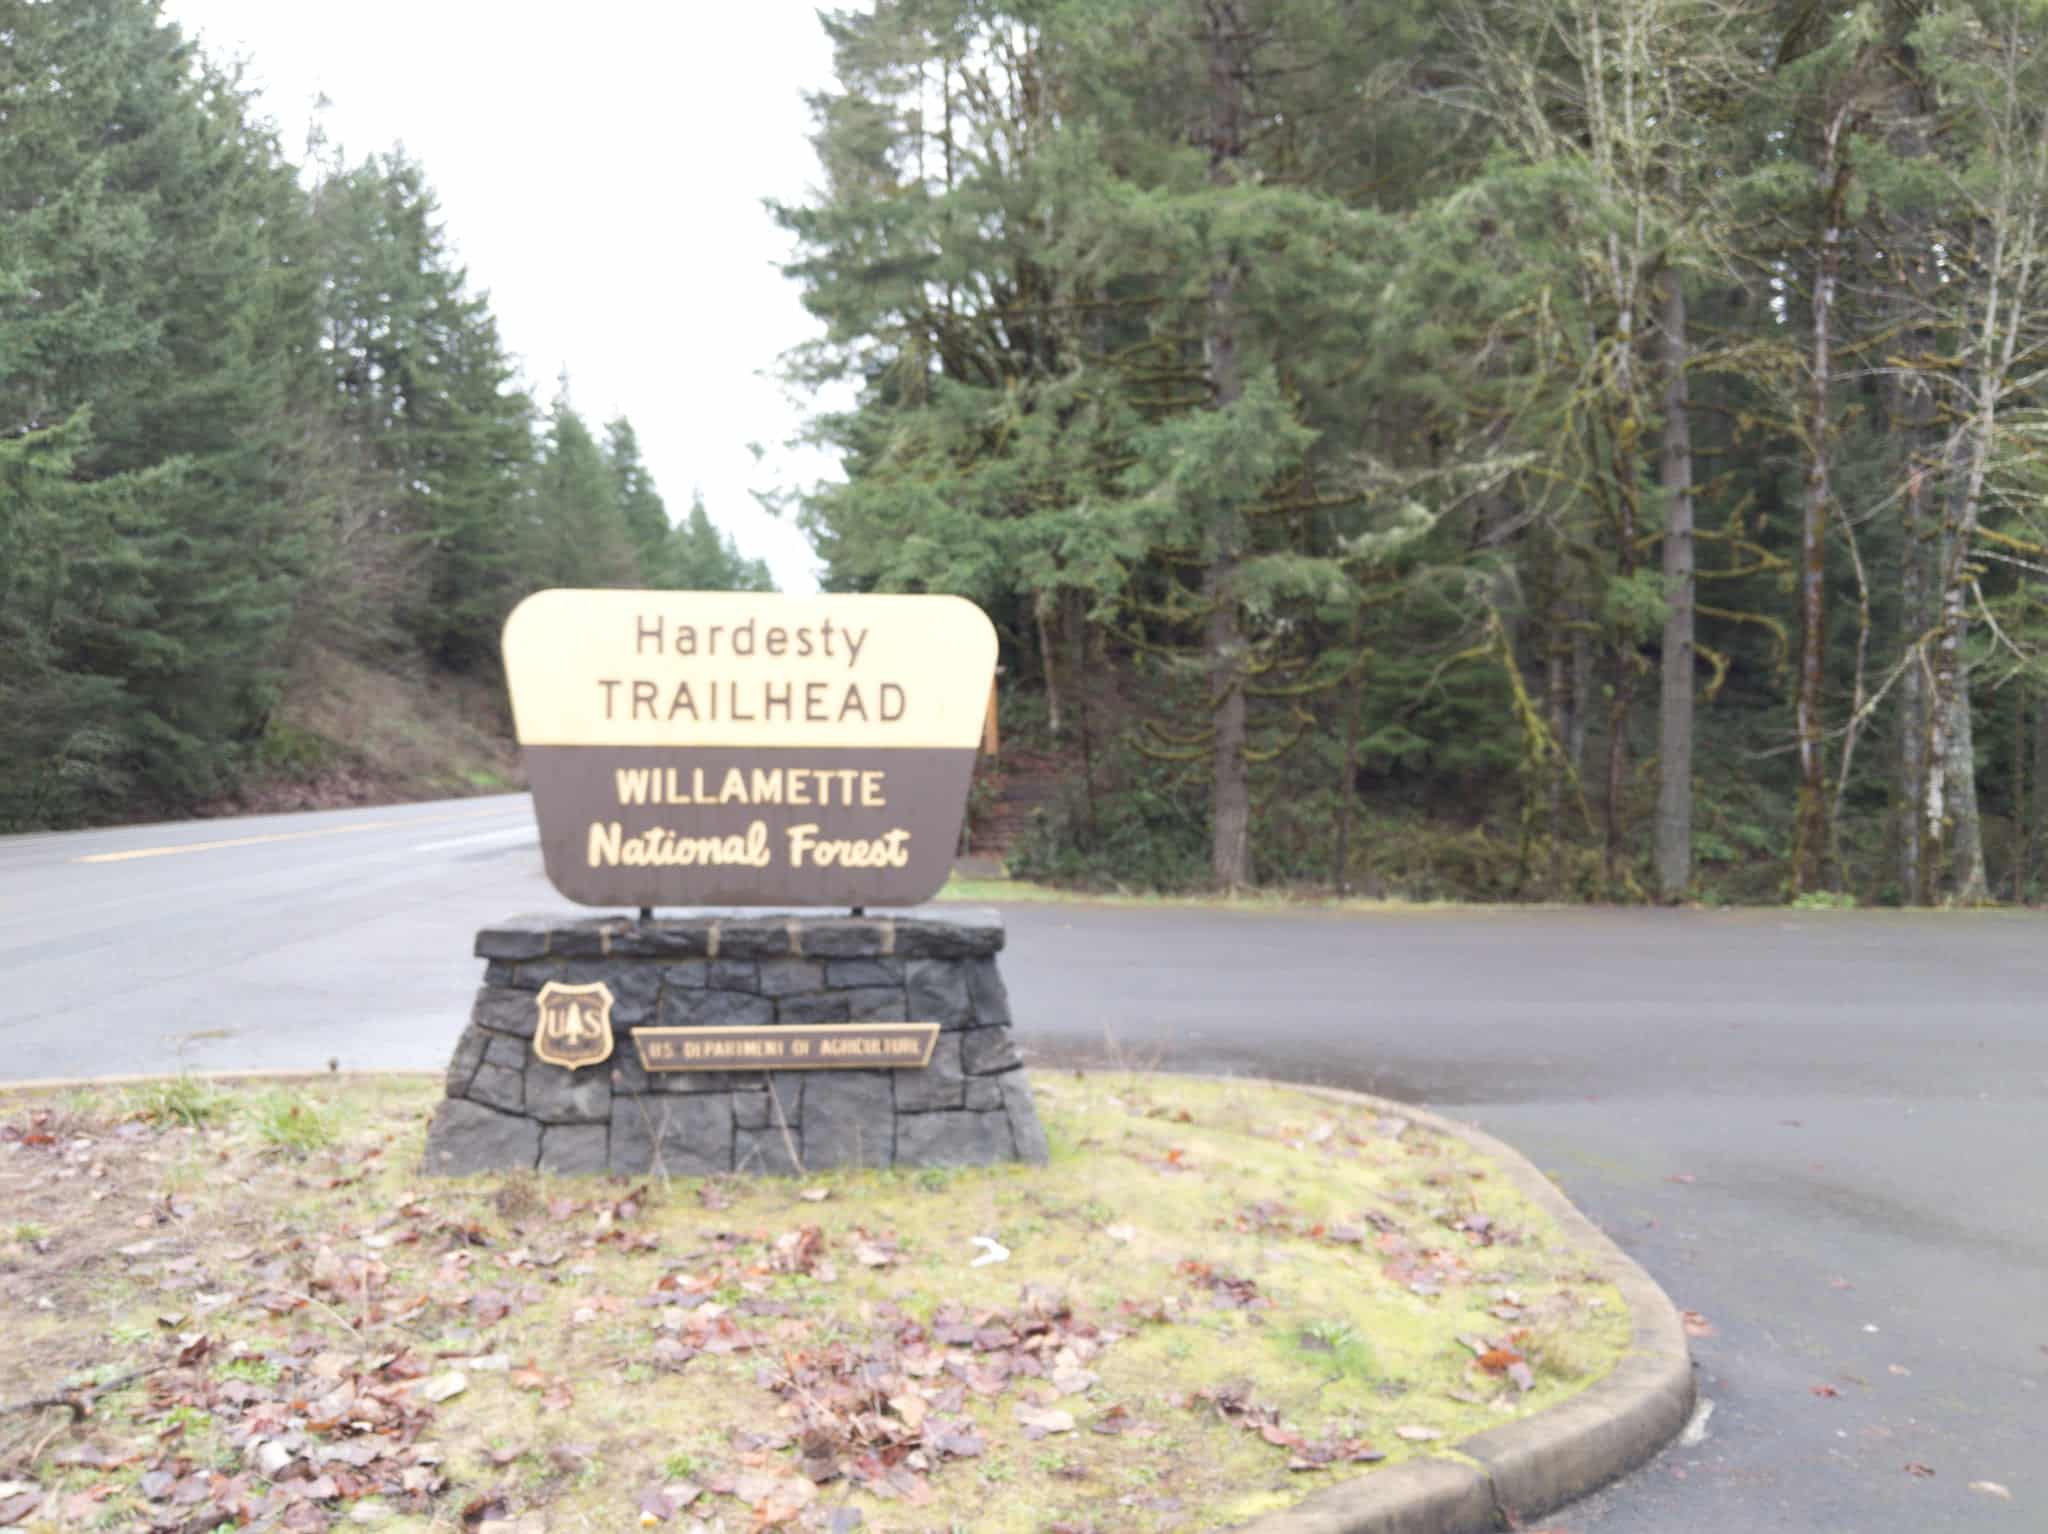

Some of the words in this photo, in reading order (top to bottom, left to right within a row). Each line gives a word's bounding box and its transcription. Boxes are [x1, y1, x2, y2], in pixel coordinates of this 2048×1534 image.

[636, 615, 868, 668] Hardesty
[598, 680, 907, 722] TRAILHEAD
[616, 768, 886, 806] WILLAMETTE
[588, 820, 771, 868] National
[786, 824, 911, 867] Forest
[683, 1039, 784, 1058] DEPARTMENT
[819, 1037, 921, 1057] AGRICULTURE
